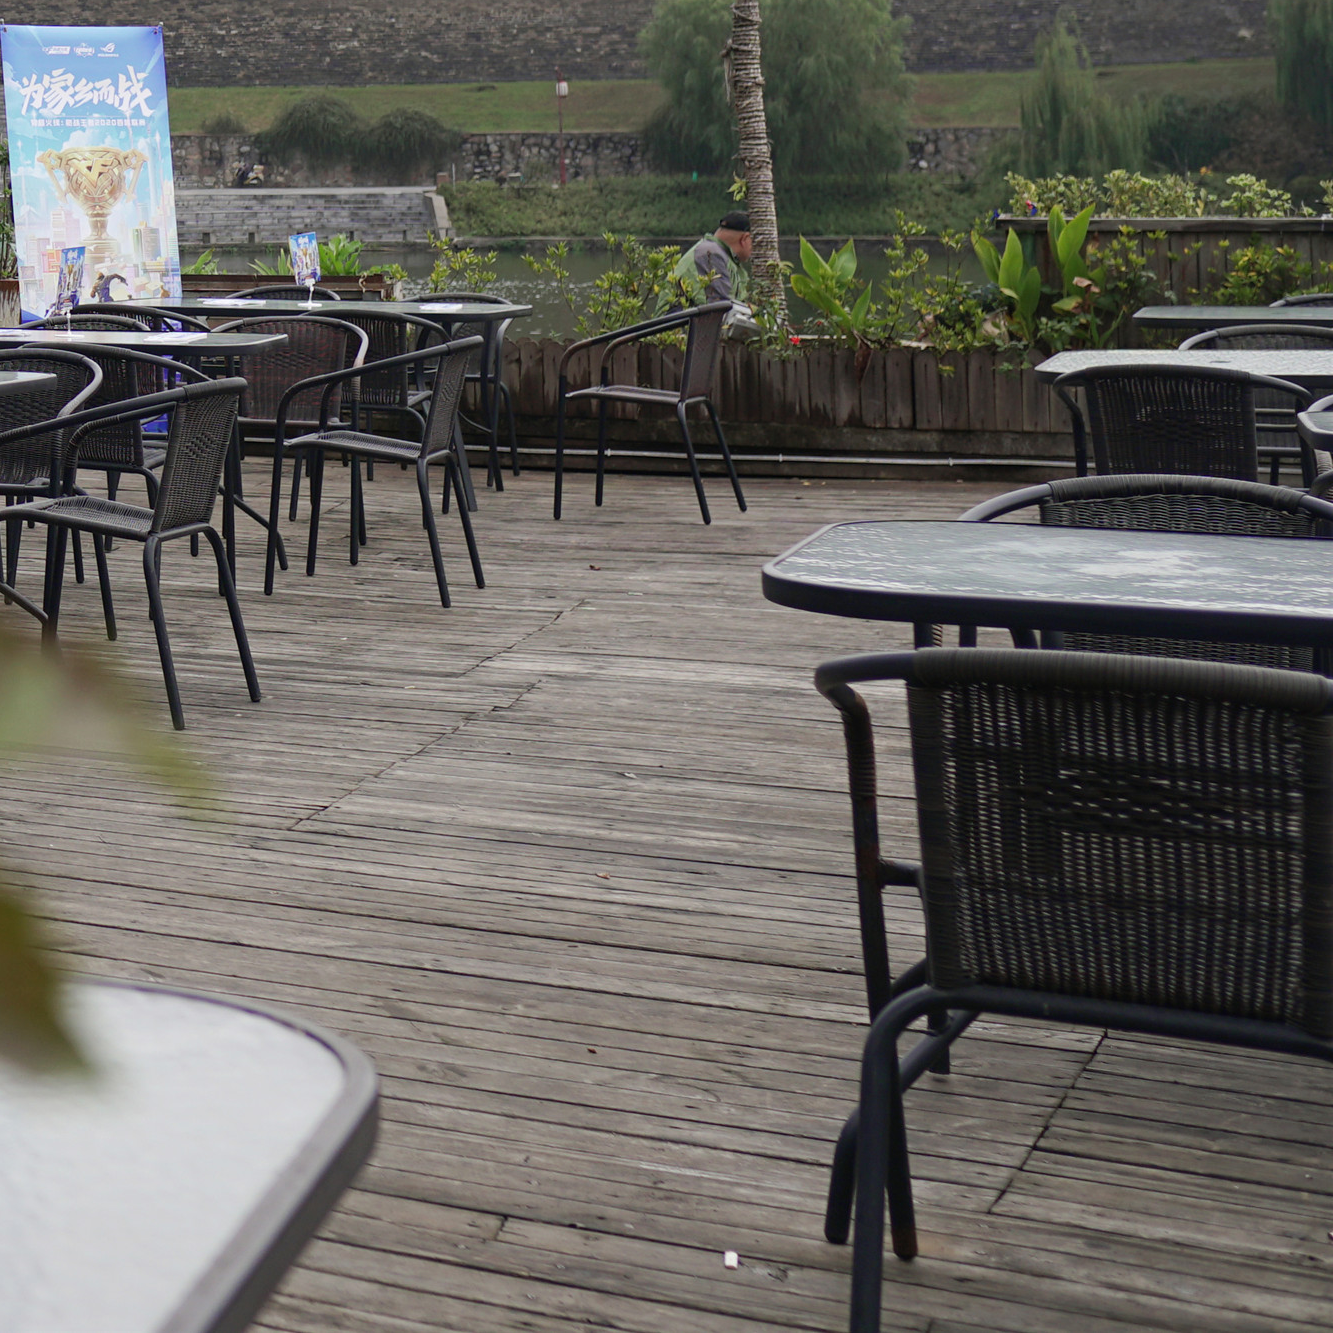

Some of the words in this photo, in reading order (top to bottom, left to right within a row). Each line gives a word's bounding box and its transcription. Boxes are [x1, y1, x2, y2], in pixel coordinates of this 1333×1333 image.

[19, 64, 156, 118] 为家乡而战
